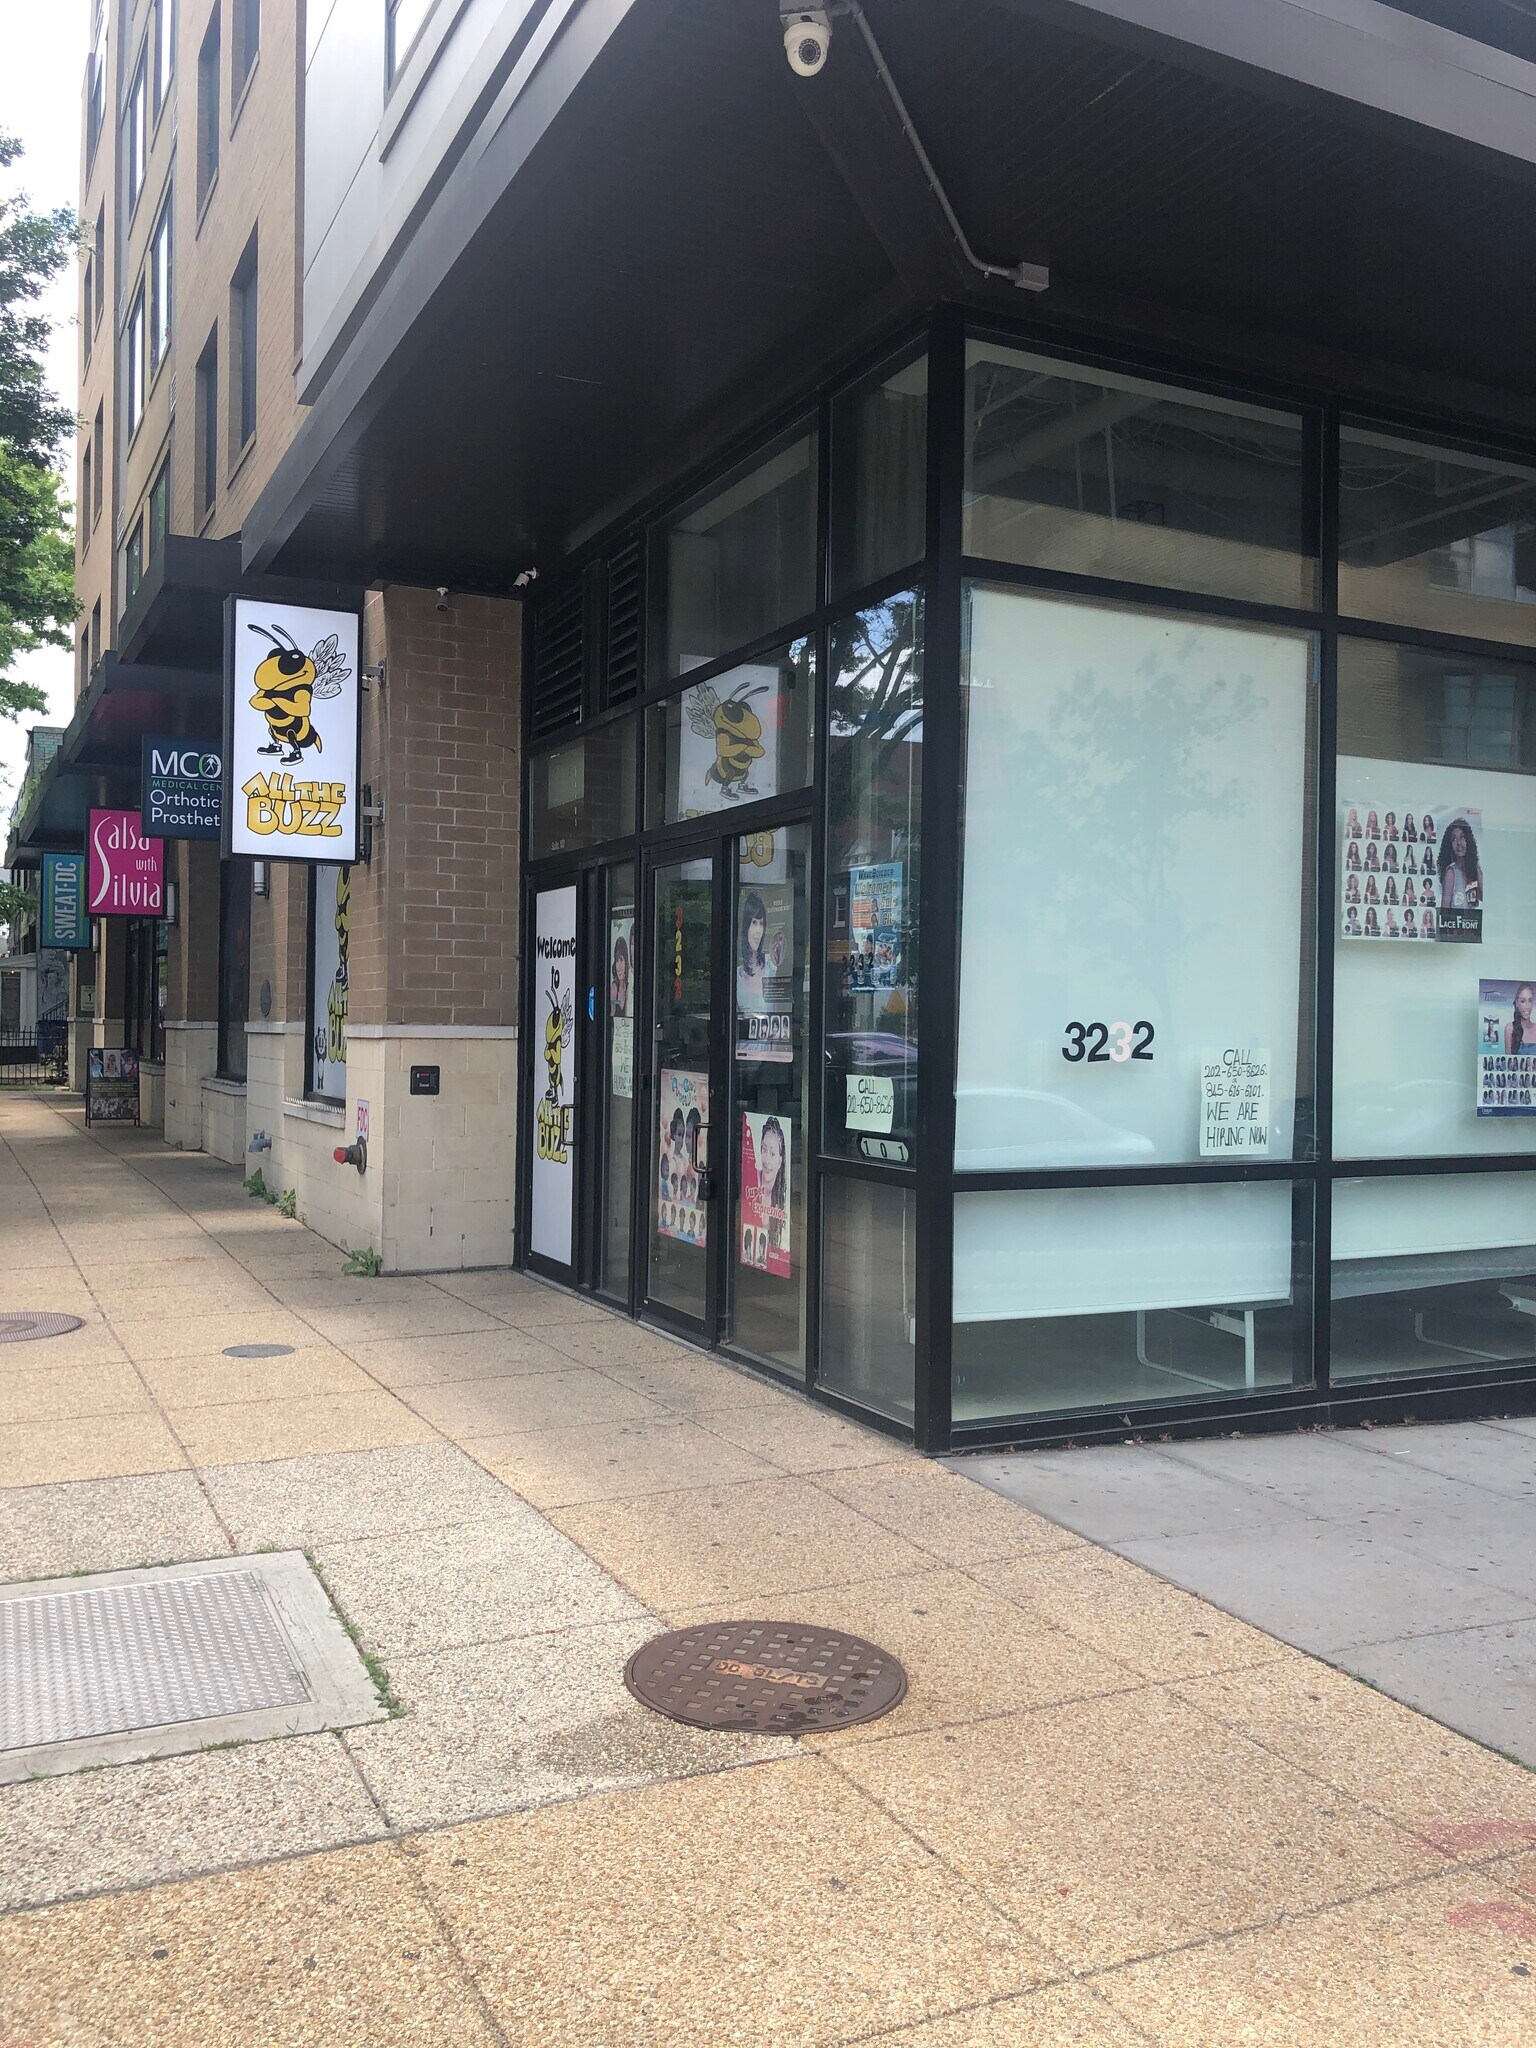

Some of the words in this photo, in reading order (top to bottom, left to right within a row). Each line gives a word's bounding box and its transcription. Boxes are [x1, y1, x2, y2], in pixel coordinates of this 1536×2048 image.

[152, 780, 198, 790] MEDICAL
[202, 783, 223, 791] CEN
[241, 771, 295, 801] ALL
[293, 781, 346, 804] THE
[150, 789, 222, 808] Orthotic
[152, 807, 221, 826] Prosthet
[247, 796, 342, 837] BUZZ
[135, 857, 157, 872] with
[537, 936, 576, 959] Welcome
[674, 906, 684, 999] 3232
[551, 966, 560, 989] to
[1062, 1020, 1154, 1062] 3232
[1223, 1049, 1252, 1066] CALL
[858, 1079, 878, 1095] CALL
[1207, 1102, 1230, 1121] WE
[1237, 1102, 1259, 1121] ARE
[1206, 1126, 1245, 1147] HIRING
[1249, 1126, 1268, 1146] NOW
